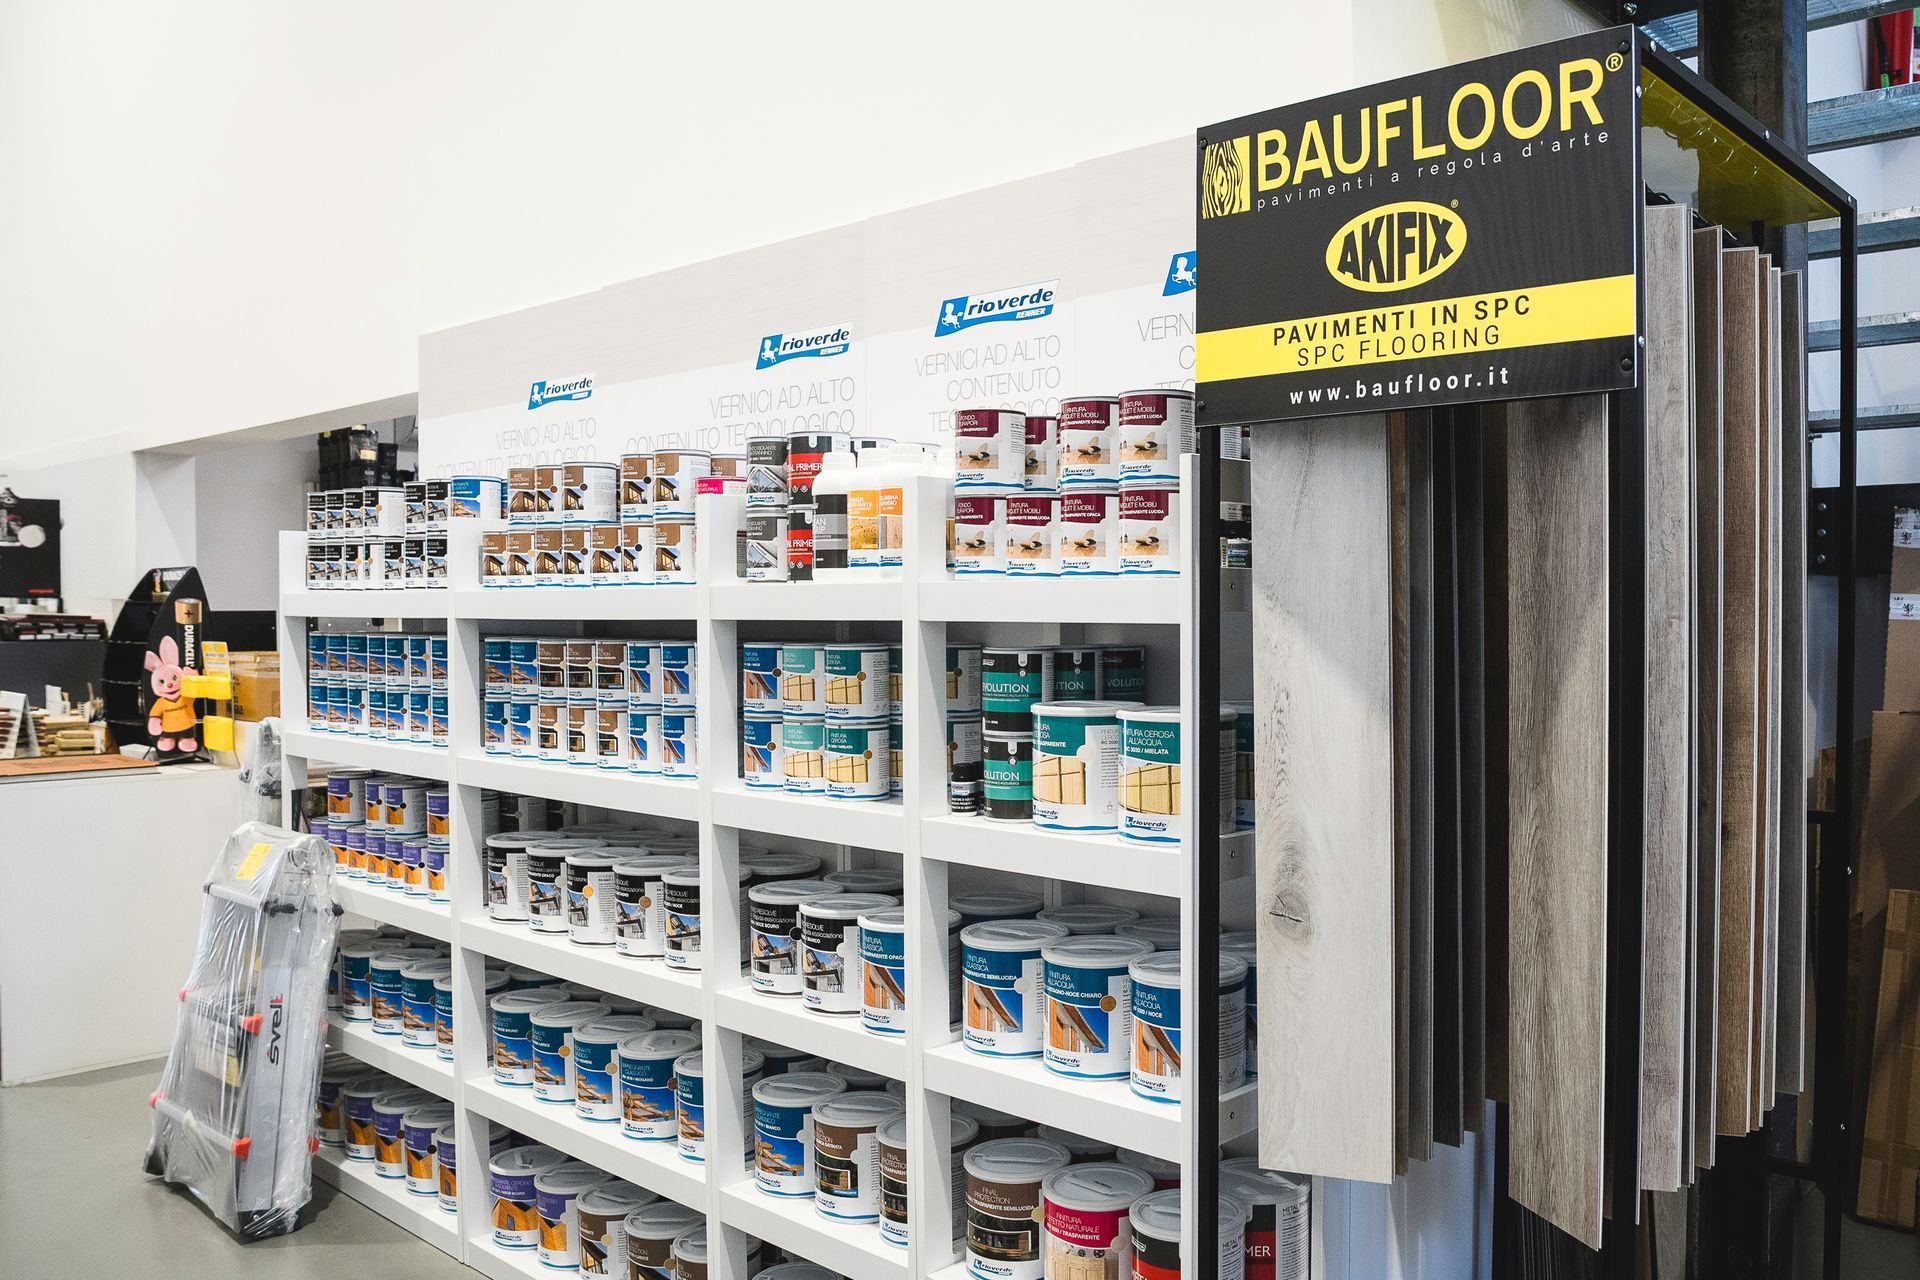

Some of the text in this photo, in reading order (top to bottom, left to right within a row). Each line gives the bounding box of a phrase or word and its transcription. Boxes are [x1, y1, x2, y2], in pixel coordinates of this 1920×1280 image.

[1257, 131, 1609, 211] pavimenti a regola d'arte
[967, 288, 1054, 316] rioverde
[1015, 306, 1046, 320] RENNER
[1137, 311, 1195, 342] VERN
[1273, 294, 1531, 346] PAVIMENTI IN SPC
[781, 328, 850, 351] rioverde
[1297, 324, 1501, 367] SPC FLOORING
[915, 335, 1061, 377] VERNICI AD ALTO
[545, 377, 593, 395] rioverde
[946, 365, 1061, 402] CONTENUTO
[1289, 366, 1510, 405] www.baufloor.it
[710, 376, 855, 419] VERNICI AD ALTO
[495, 417, 597, 451] VERNICI AD ALTO
[796, 462, 824, 471] PRIMER
[792, 539, 813, 548] PRIME
[184, 624, 195, 667] DURACELL
[1144, 729, 1175, 739] CEROSA
[983, 770, 1020, 781] OLUTION
[1132, 819, 1167, 828] rioverde
[986, 973, 1018, 981] SEMILUCIDA
[1148, 1011, 1163, 1019] NOCE
[974, 1190, 1011, 1204] PROTECTION
[982, 1187, 998, 1197] FINAL
[1003, 1204, 1035, 1212] SEMILUCIDA
[1282, 1204, 1299, 1214] METAL
[1055, 1212, 1082, 1225] FINITURA
[1066, 1221, 1100, 1233] NATURALE
[1062, 1229, 1100, 1241] TRASPARENTE
[1222, 1237, 1238, 1249] METAL
[1245, 1246, 1272, 1257] MER
[981, 1263, 1013, 1273] rioverde
